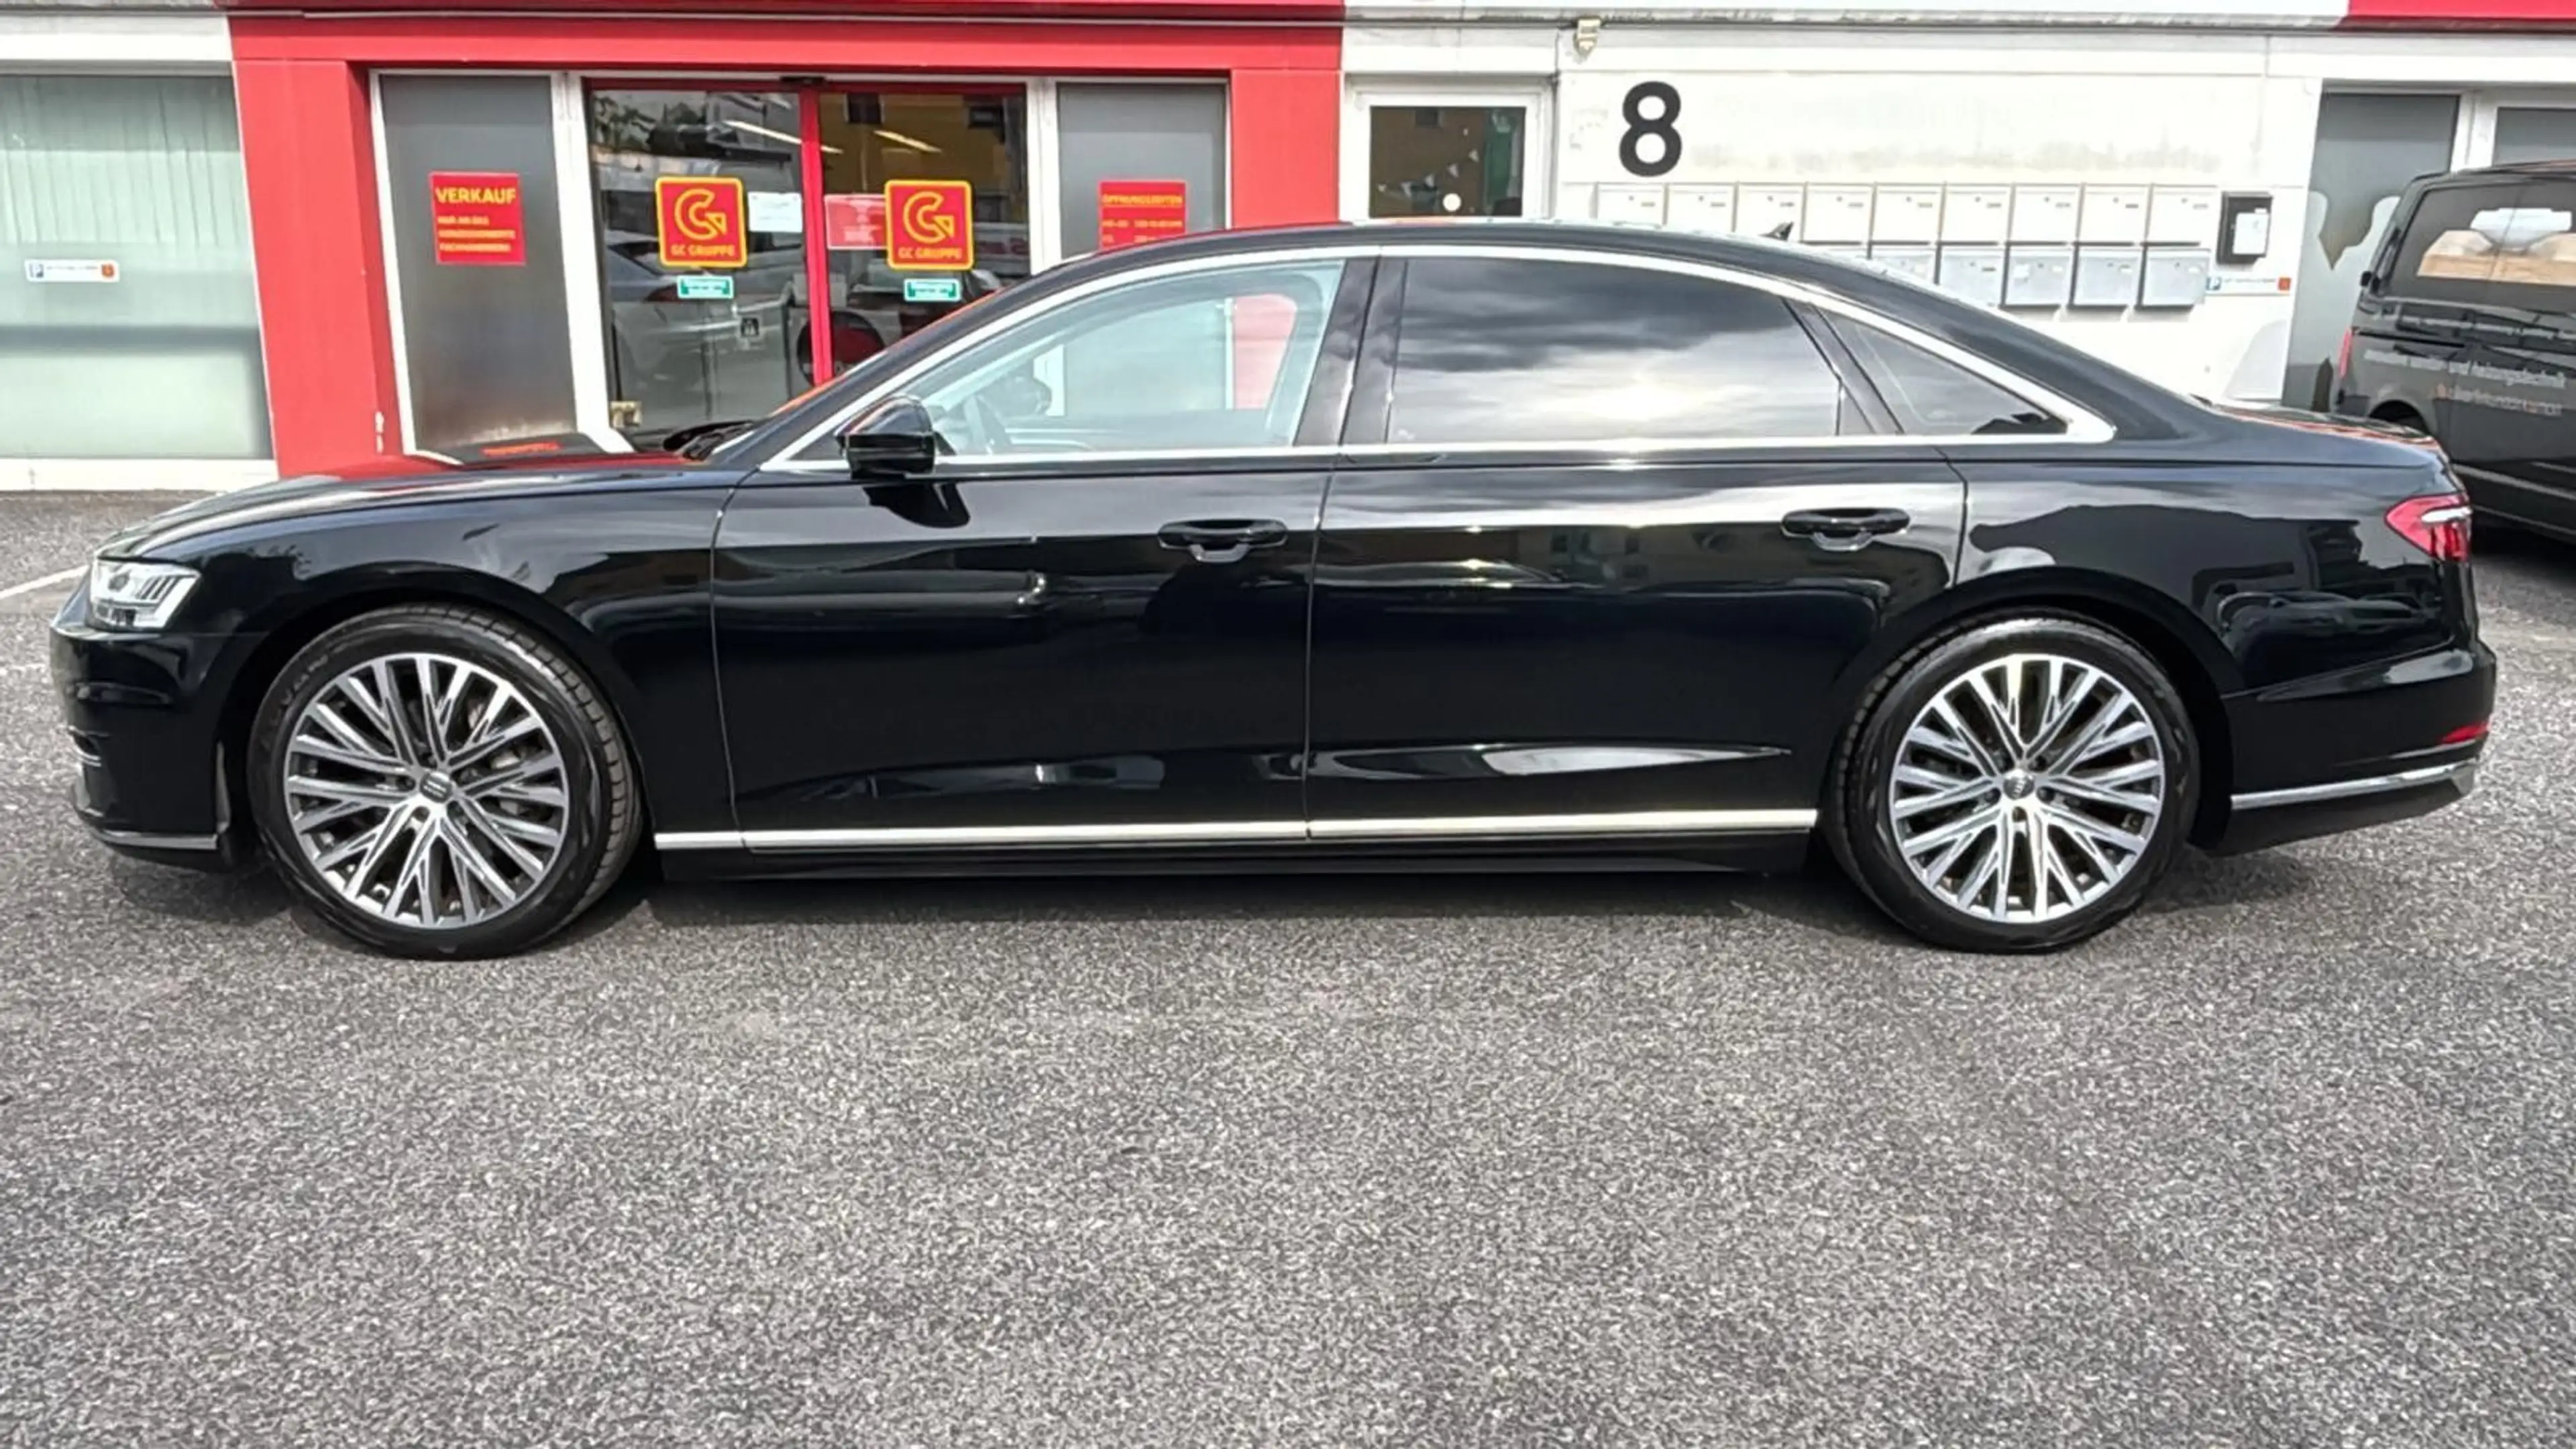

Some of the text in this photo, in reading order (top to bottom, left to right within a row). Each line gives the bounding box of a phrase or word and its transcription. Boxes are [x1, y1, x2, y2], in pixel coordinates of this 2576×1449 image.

[1619, 80, 1682, 178] 8
[435, 187, 517, 205] VERKAUF
[670, 244, 735, 257] GC GRUPPE
[898, 247, 963, 260] GC GRUPPE
